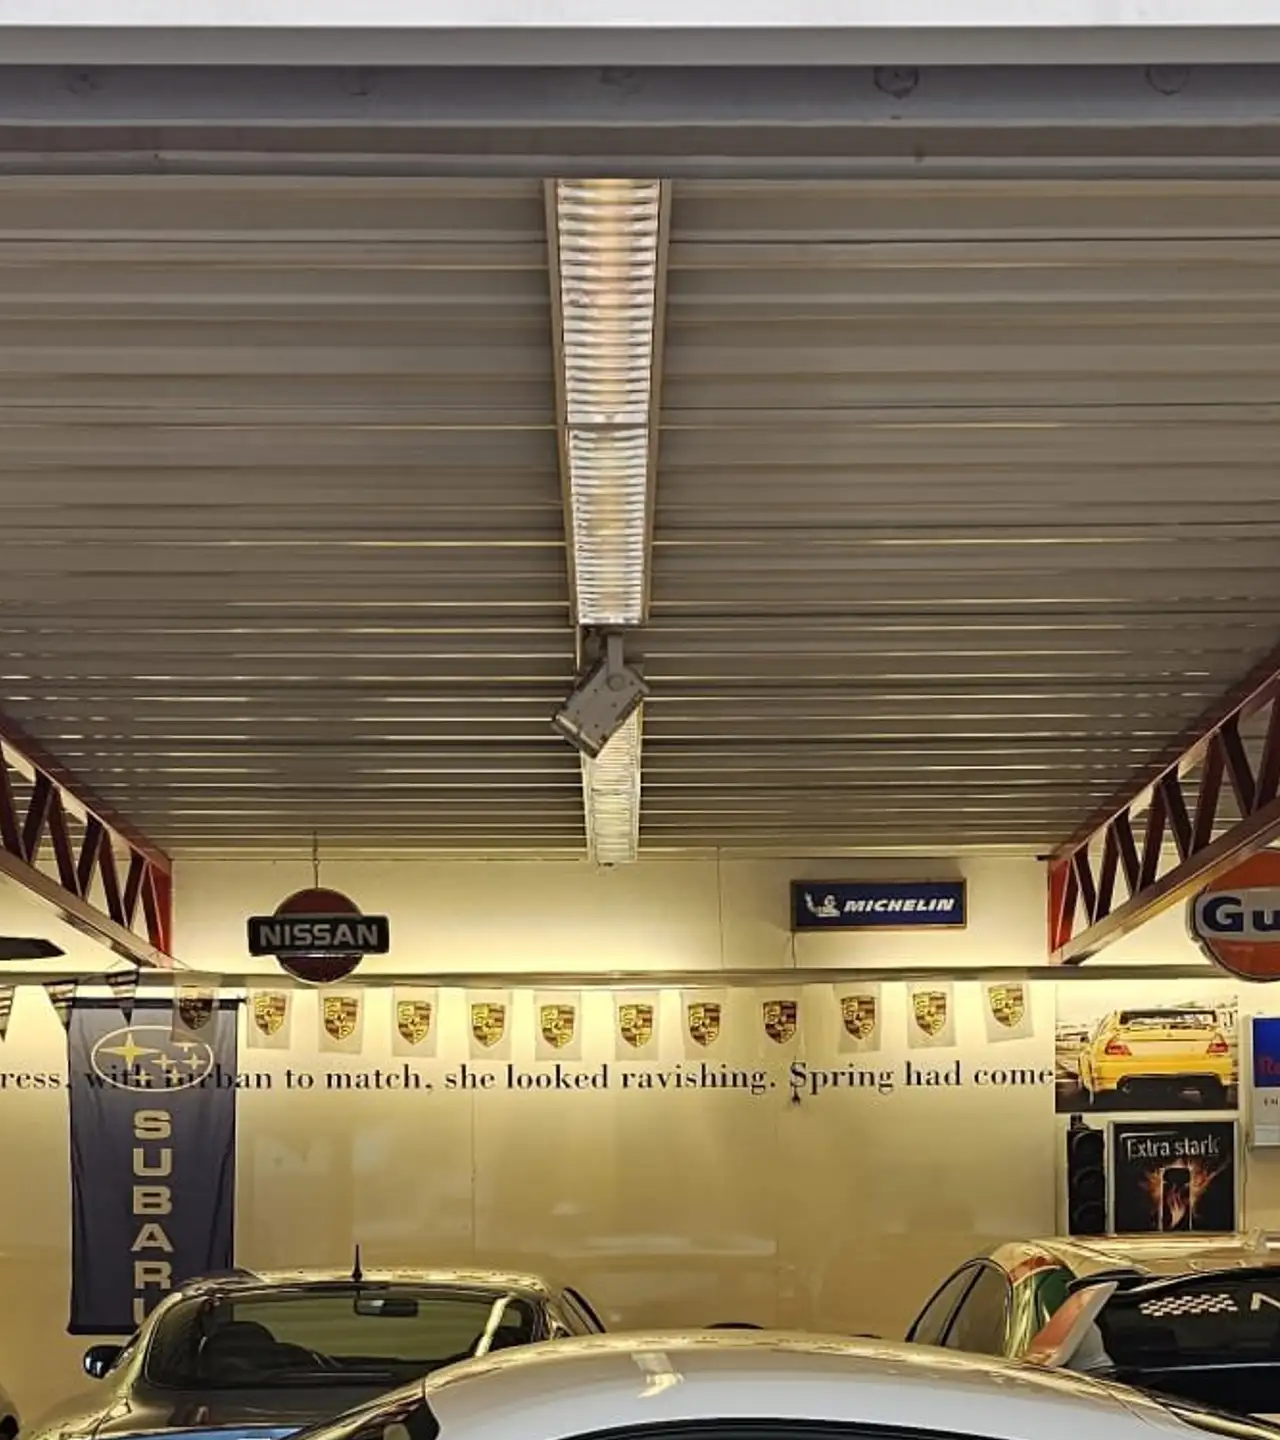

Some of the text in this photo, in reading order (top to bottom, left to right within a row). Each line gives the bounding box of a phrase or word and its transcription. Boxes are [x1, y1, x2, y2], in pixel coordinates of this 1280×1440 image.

[843, 898, 955, 912] MICHELIN
[259, 923, 378, 946] NISSAN
[286, 1068, 315, 1089] to
[326, 1064, 434, 1094] match,
[444, 1064, 496, 1089] she
[506, 1063, 609, 1089] looked
[621, 1064, 777, 1095] ravishing.
[788, 1062, 895, 1095] Spring
[903, 1060, 963, 1087] had
[973, 1069, 1055, 1087] come
[1127, 1134, 1220, 1159] Extra stark
